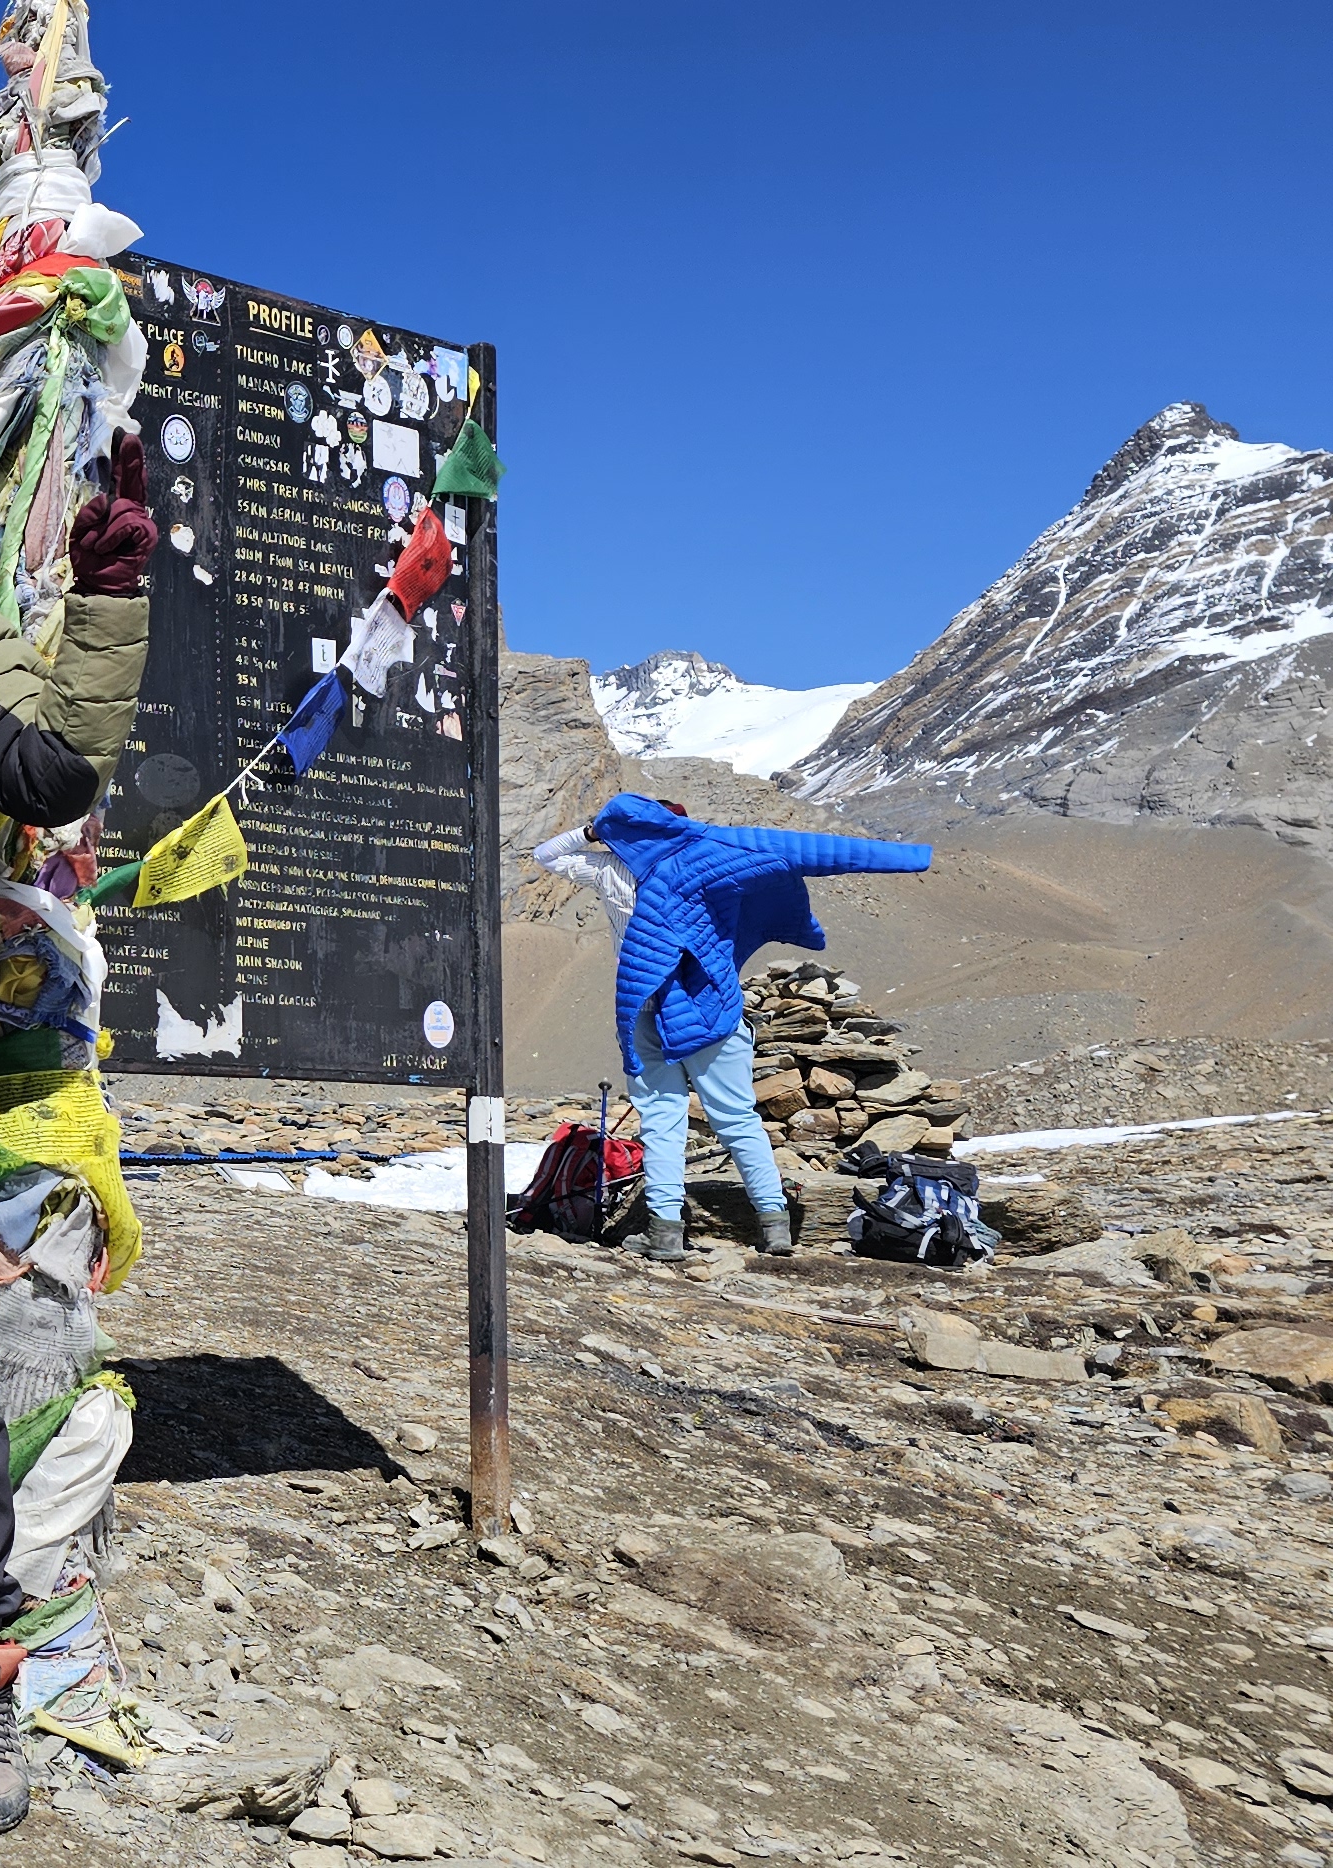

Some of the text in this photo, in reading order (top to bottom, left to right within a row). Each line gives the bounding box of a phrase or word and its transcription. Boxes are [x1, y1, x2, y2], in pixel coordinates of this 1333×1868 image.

[248, 300, 314, 338] PROFILE
[147, 323, 184, 344] PLACE
[234, 344, 313, 377] TILICHO LAKE
[237, 373, 285, 397] MANANG
[237, 399, 286, 421] WESTERN
[236, 425, 282, 449] GANDAKI
[272, 482, 299, 500] TREK
[269, 507, 309, 526] AERIAL
[313, 514, 364, 538] DISTANCE
[235, 525, 259, 541] HIGH
[261, 531, 307, 550] ALTITUDE
[313, 584, 345, 601] NORTH
[140, 945, 170, 960] ZONE
[235, 935, 270, 950] ALPINE
[236, 954, 263, 969] RAIN
[234, 972, 269, 986] ALPINE
